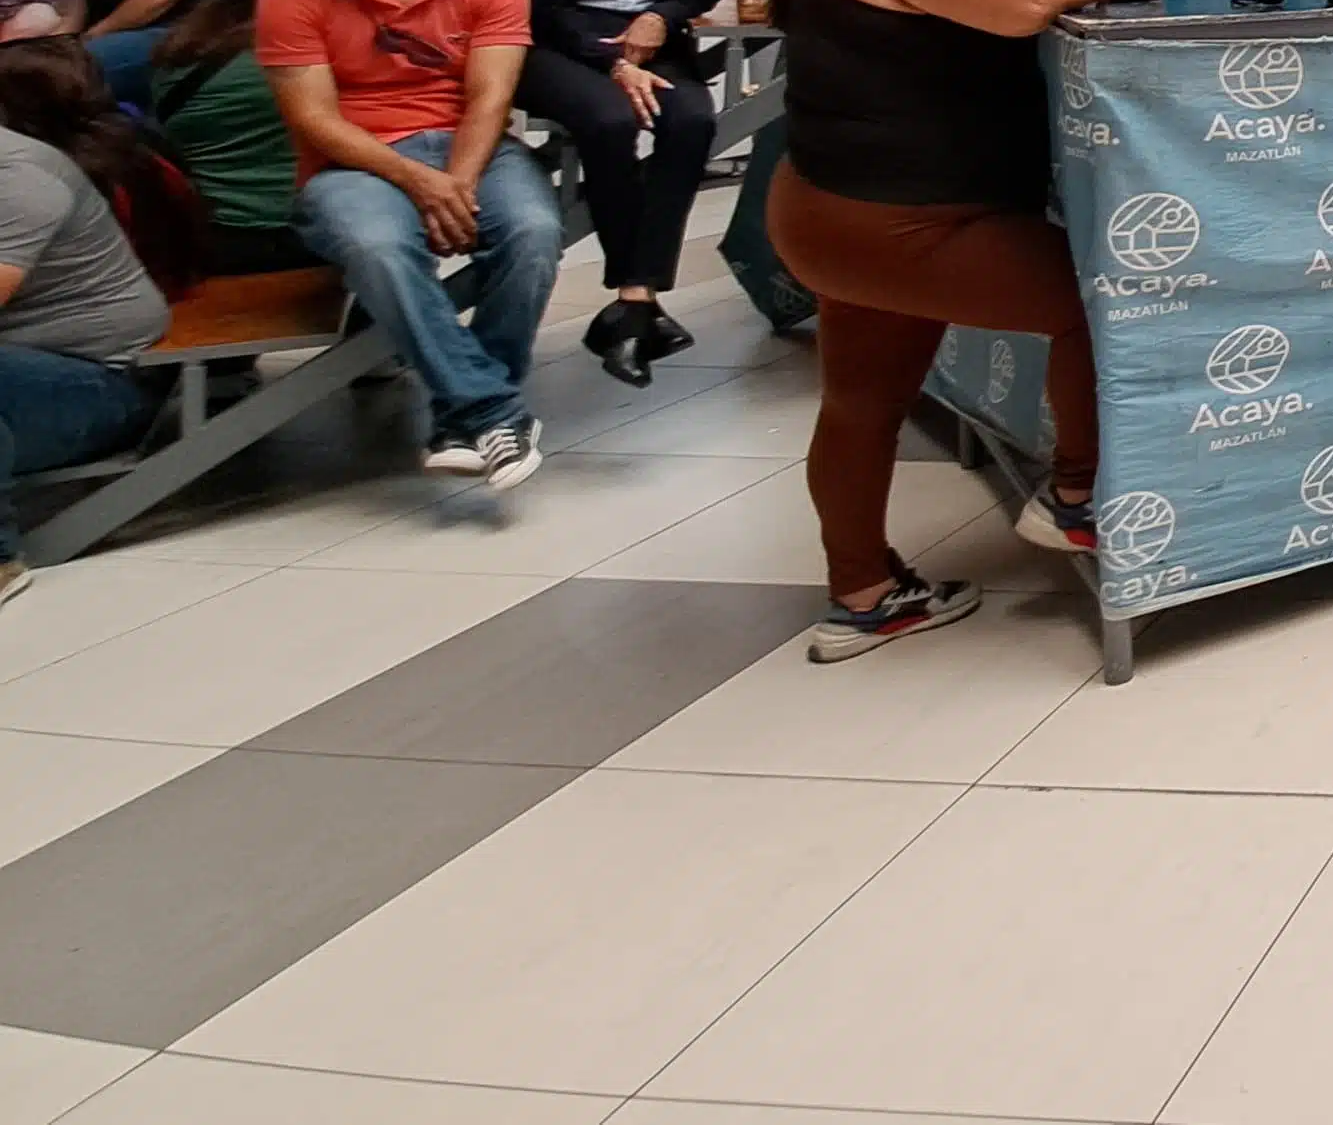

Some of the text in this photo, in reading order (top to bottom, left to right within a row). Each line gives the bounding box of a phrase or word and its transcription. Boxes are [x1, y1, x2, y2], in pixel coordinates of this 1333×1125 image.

[1204, 111, 1326, 144] Acaya.
[1094, 272, 1218, 300] Acaya.
[1190, 390, 1313, 435] Acaya.
[1099, 561, 1198, 605] caya.
